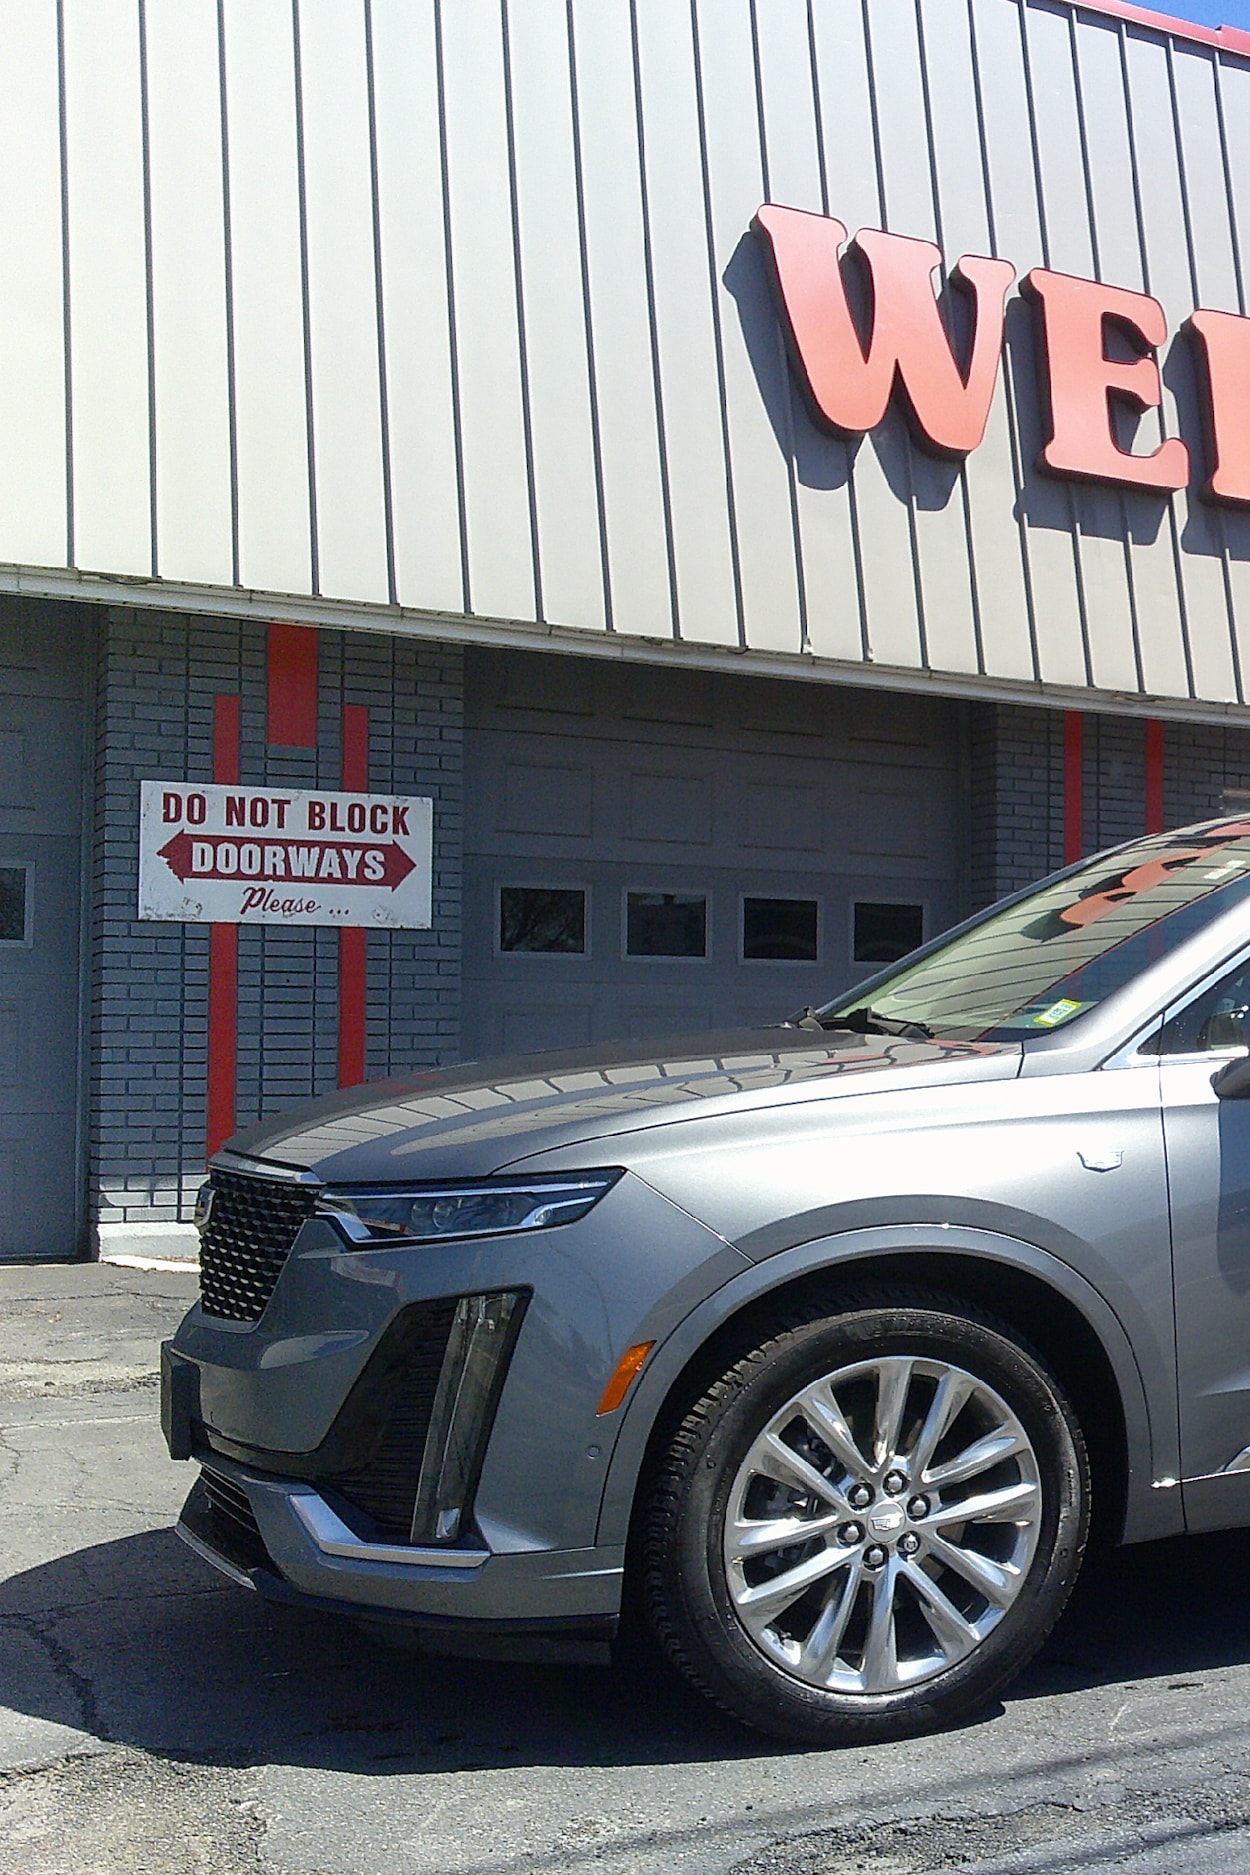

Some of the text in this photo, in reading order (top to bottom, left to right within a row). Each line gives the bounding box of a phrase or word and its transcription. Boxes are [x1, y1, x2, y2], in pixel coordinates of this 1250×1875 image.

[162, 792, 410, 836] DO NOT BLOCK
[191, 841, 385, 880] DOORWAYS
[239, 887, 322, 915] Please
